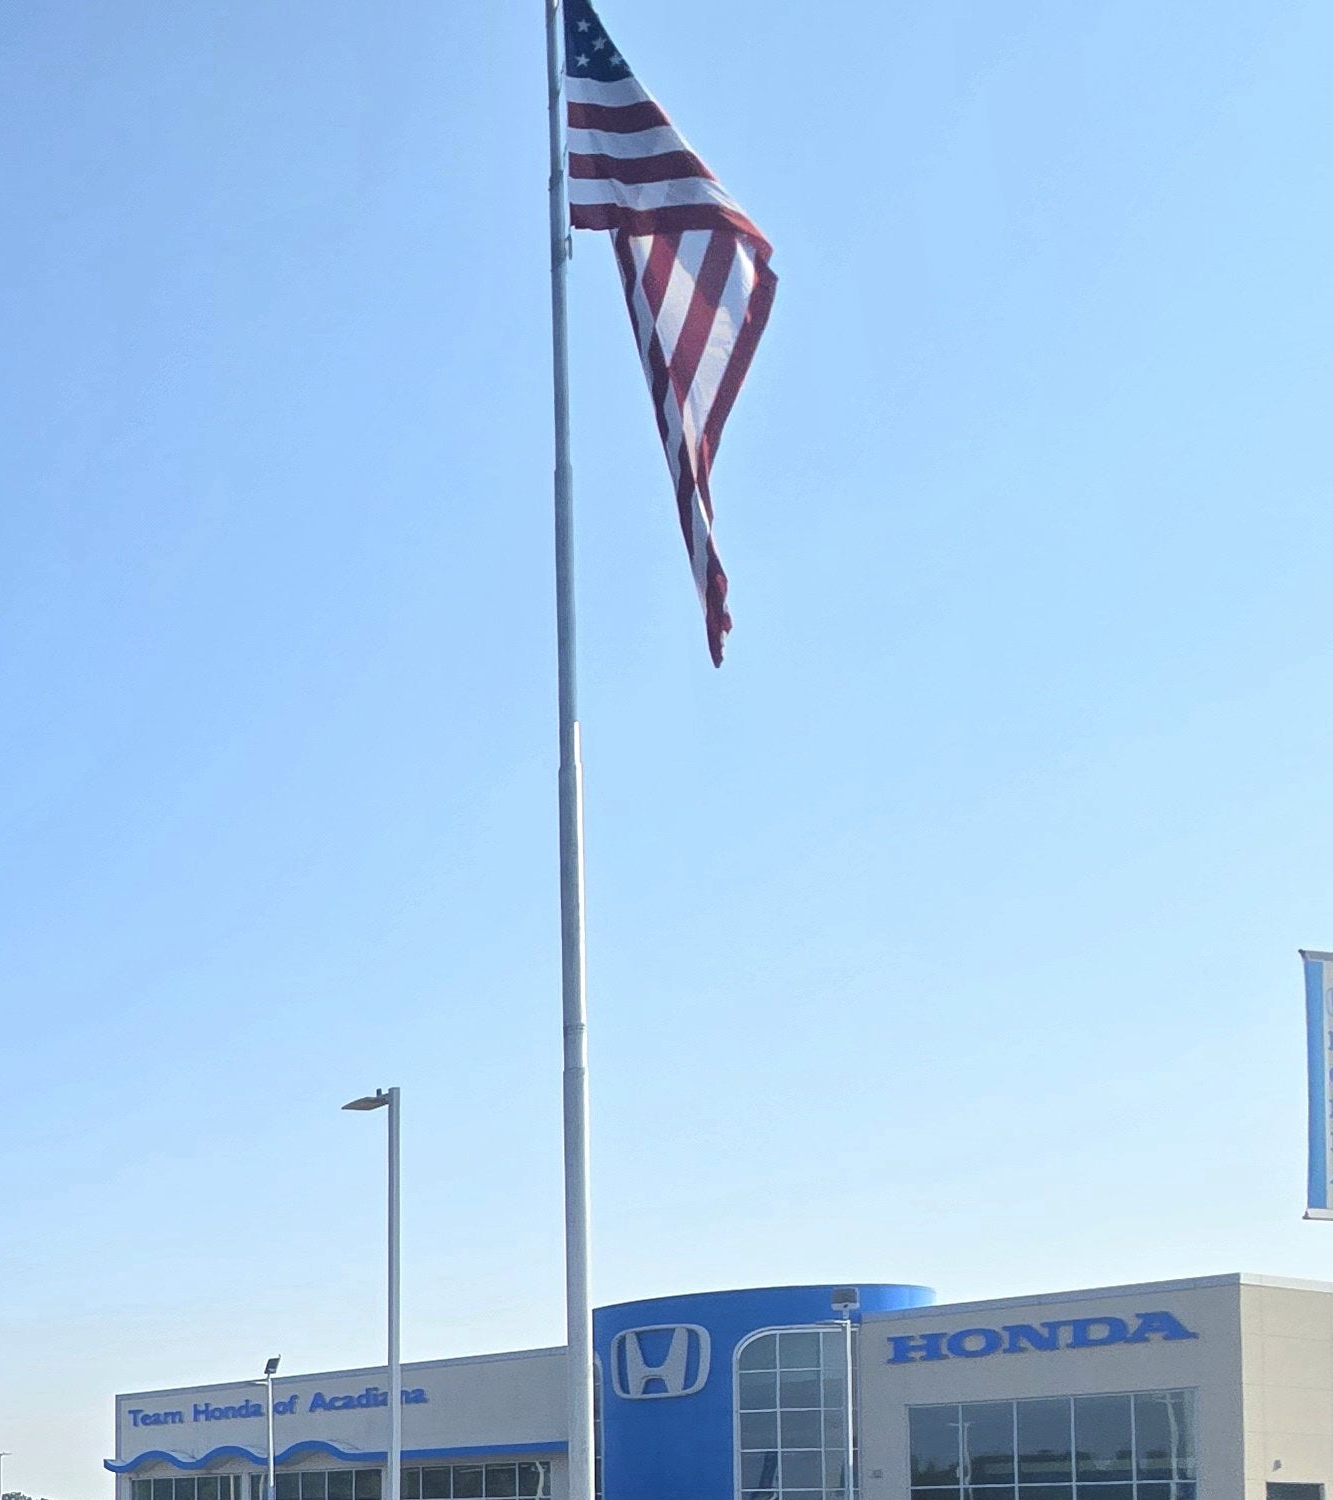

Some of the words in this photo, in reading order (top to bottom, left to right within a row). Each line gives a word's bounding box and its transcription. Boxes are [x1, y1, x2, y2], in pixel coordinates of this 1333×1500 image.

[886, 1310, 1200, 1364] HONDA
[128, 1409, 183, 1427] Team
[193, 1399, 265, 1422] Honda
[273, 1393, 299, 1415] of
